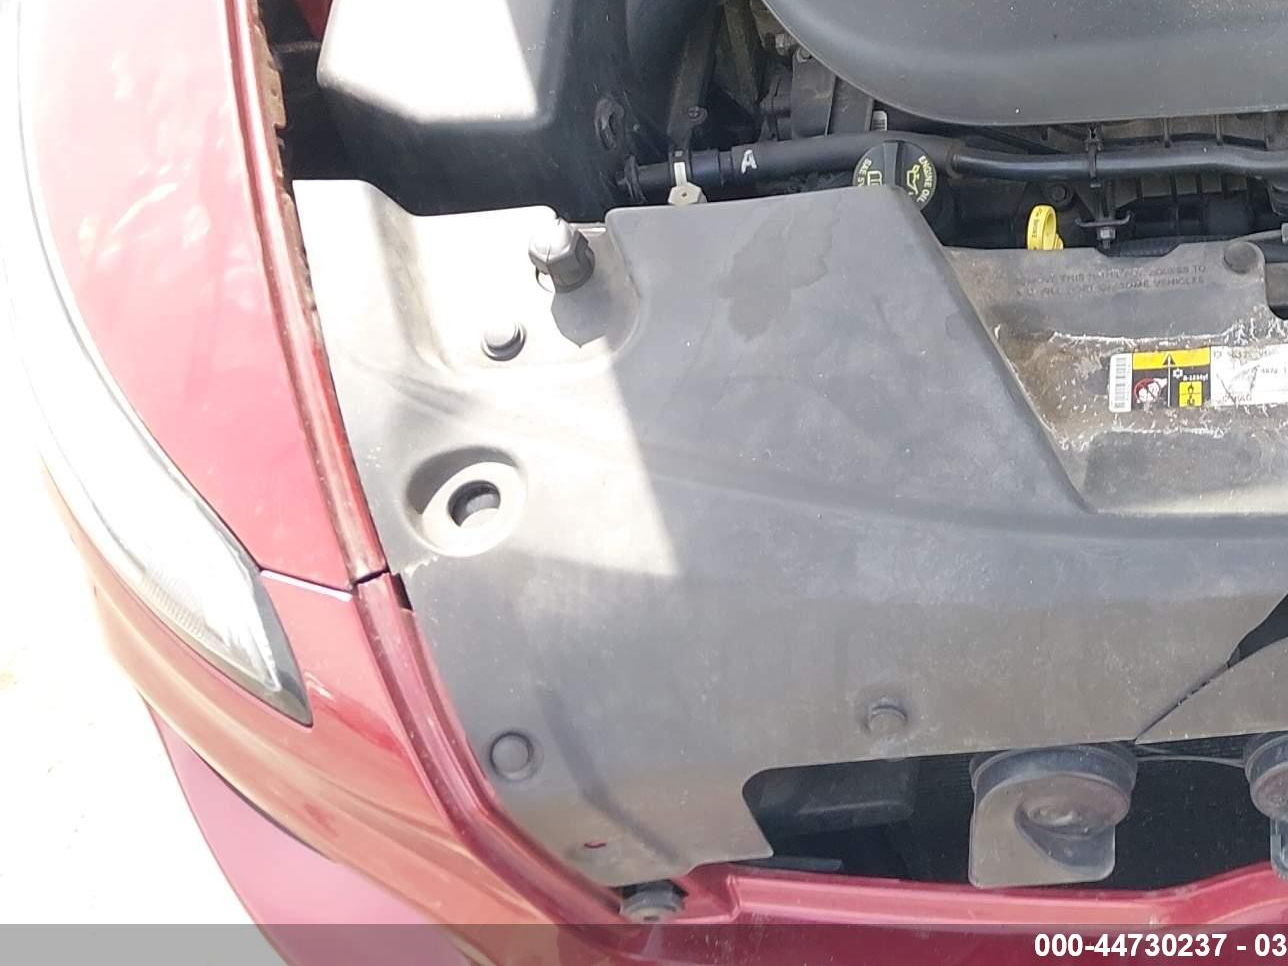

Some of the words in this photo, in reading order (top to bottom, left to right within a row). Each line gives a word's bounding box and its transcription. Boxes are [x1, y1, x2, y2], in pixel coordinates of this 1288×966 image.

[741, 149, 757, 174] A
[918, 155, 933, 188] ENGINE
[916, 189, 930, 203] OIL
